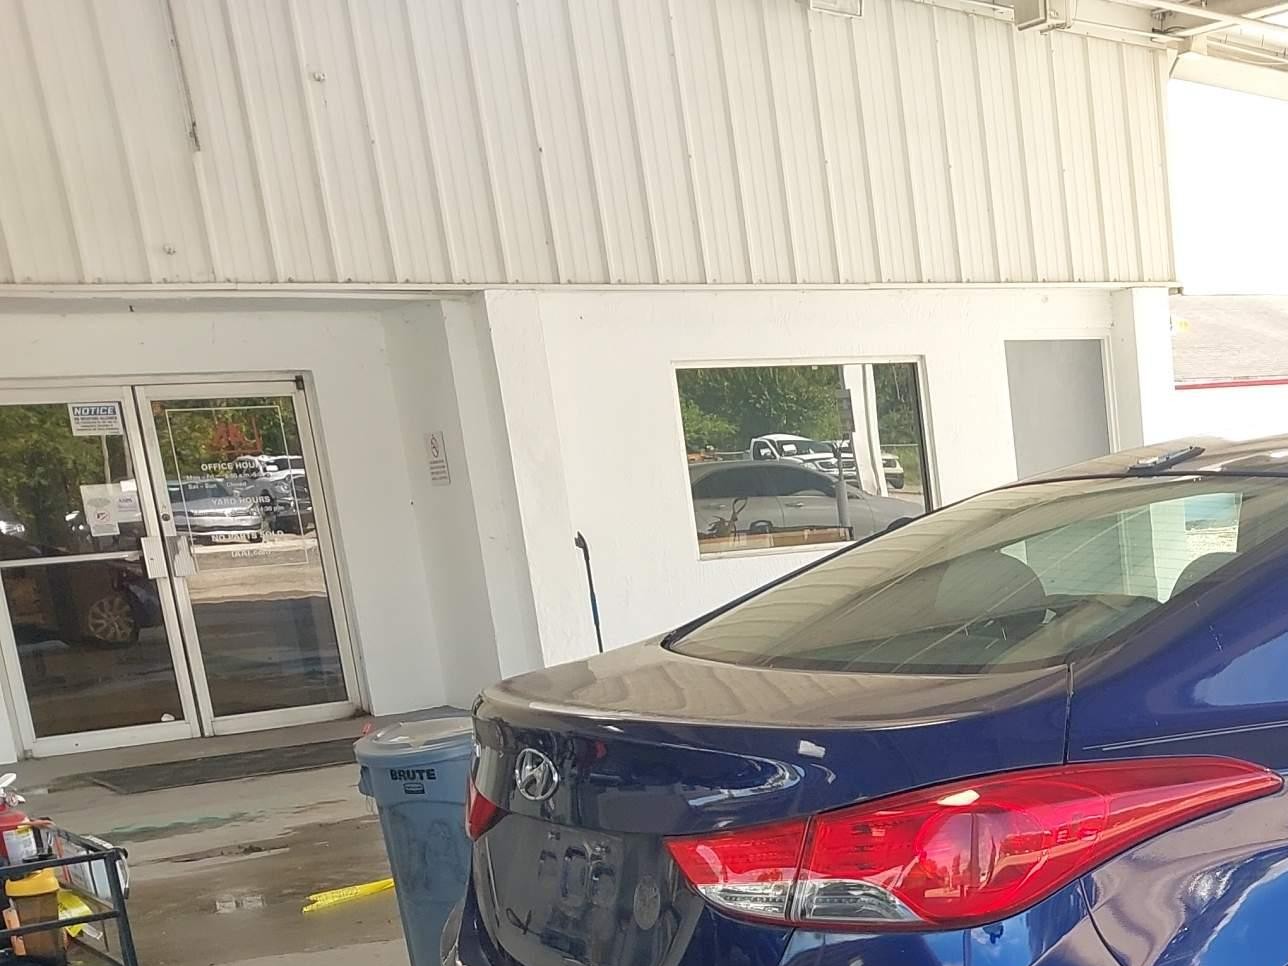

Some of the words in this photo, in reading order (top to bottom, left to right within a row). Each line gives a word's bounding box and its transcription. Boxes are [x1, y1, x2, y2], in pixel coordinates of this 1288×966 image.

[74, 406, 114, 416] NOTICE
[201, 462, 233, 471] OFFICE
[211, 498, 237, 506] YARD
[239, 496, 271, 504] HOURS
[211, 534, 225, 542] NO
[229, 533, 258, 541] PARTS
[260, 530, 284, 538] SOLD
[390, 768, 436, 781] BRUTE
